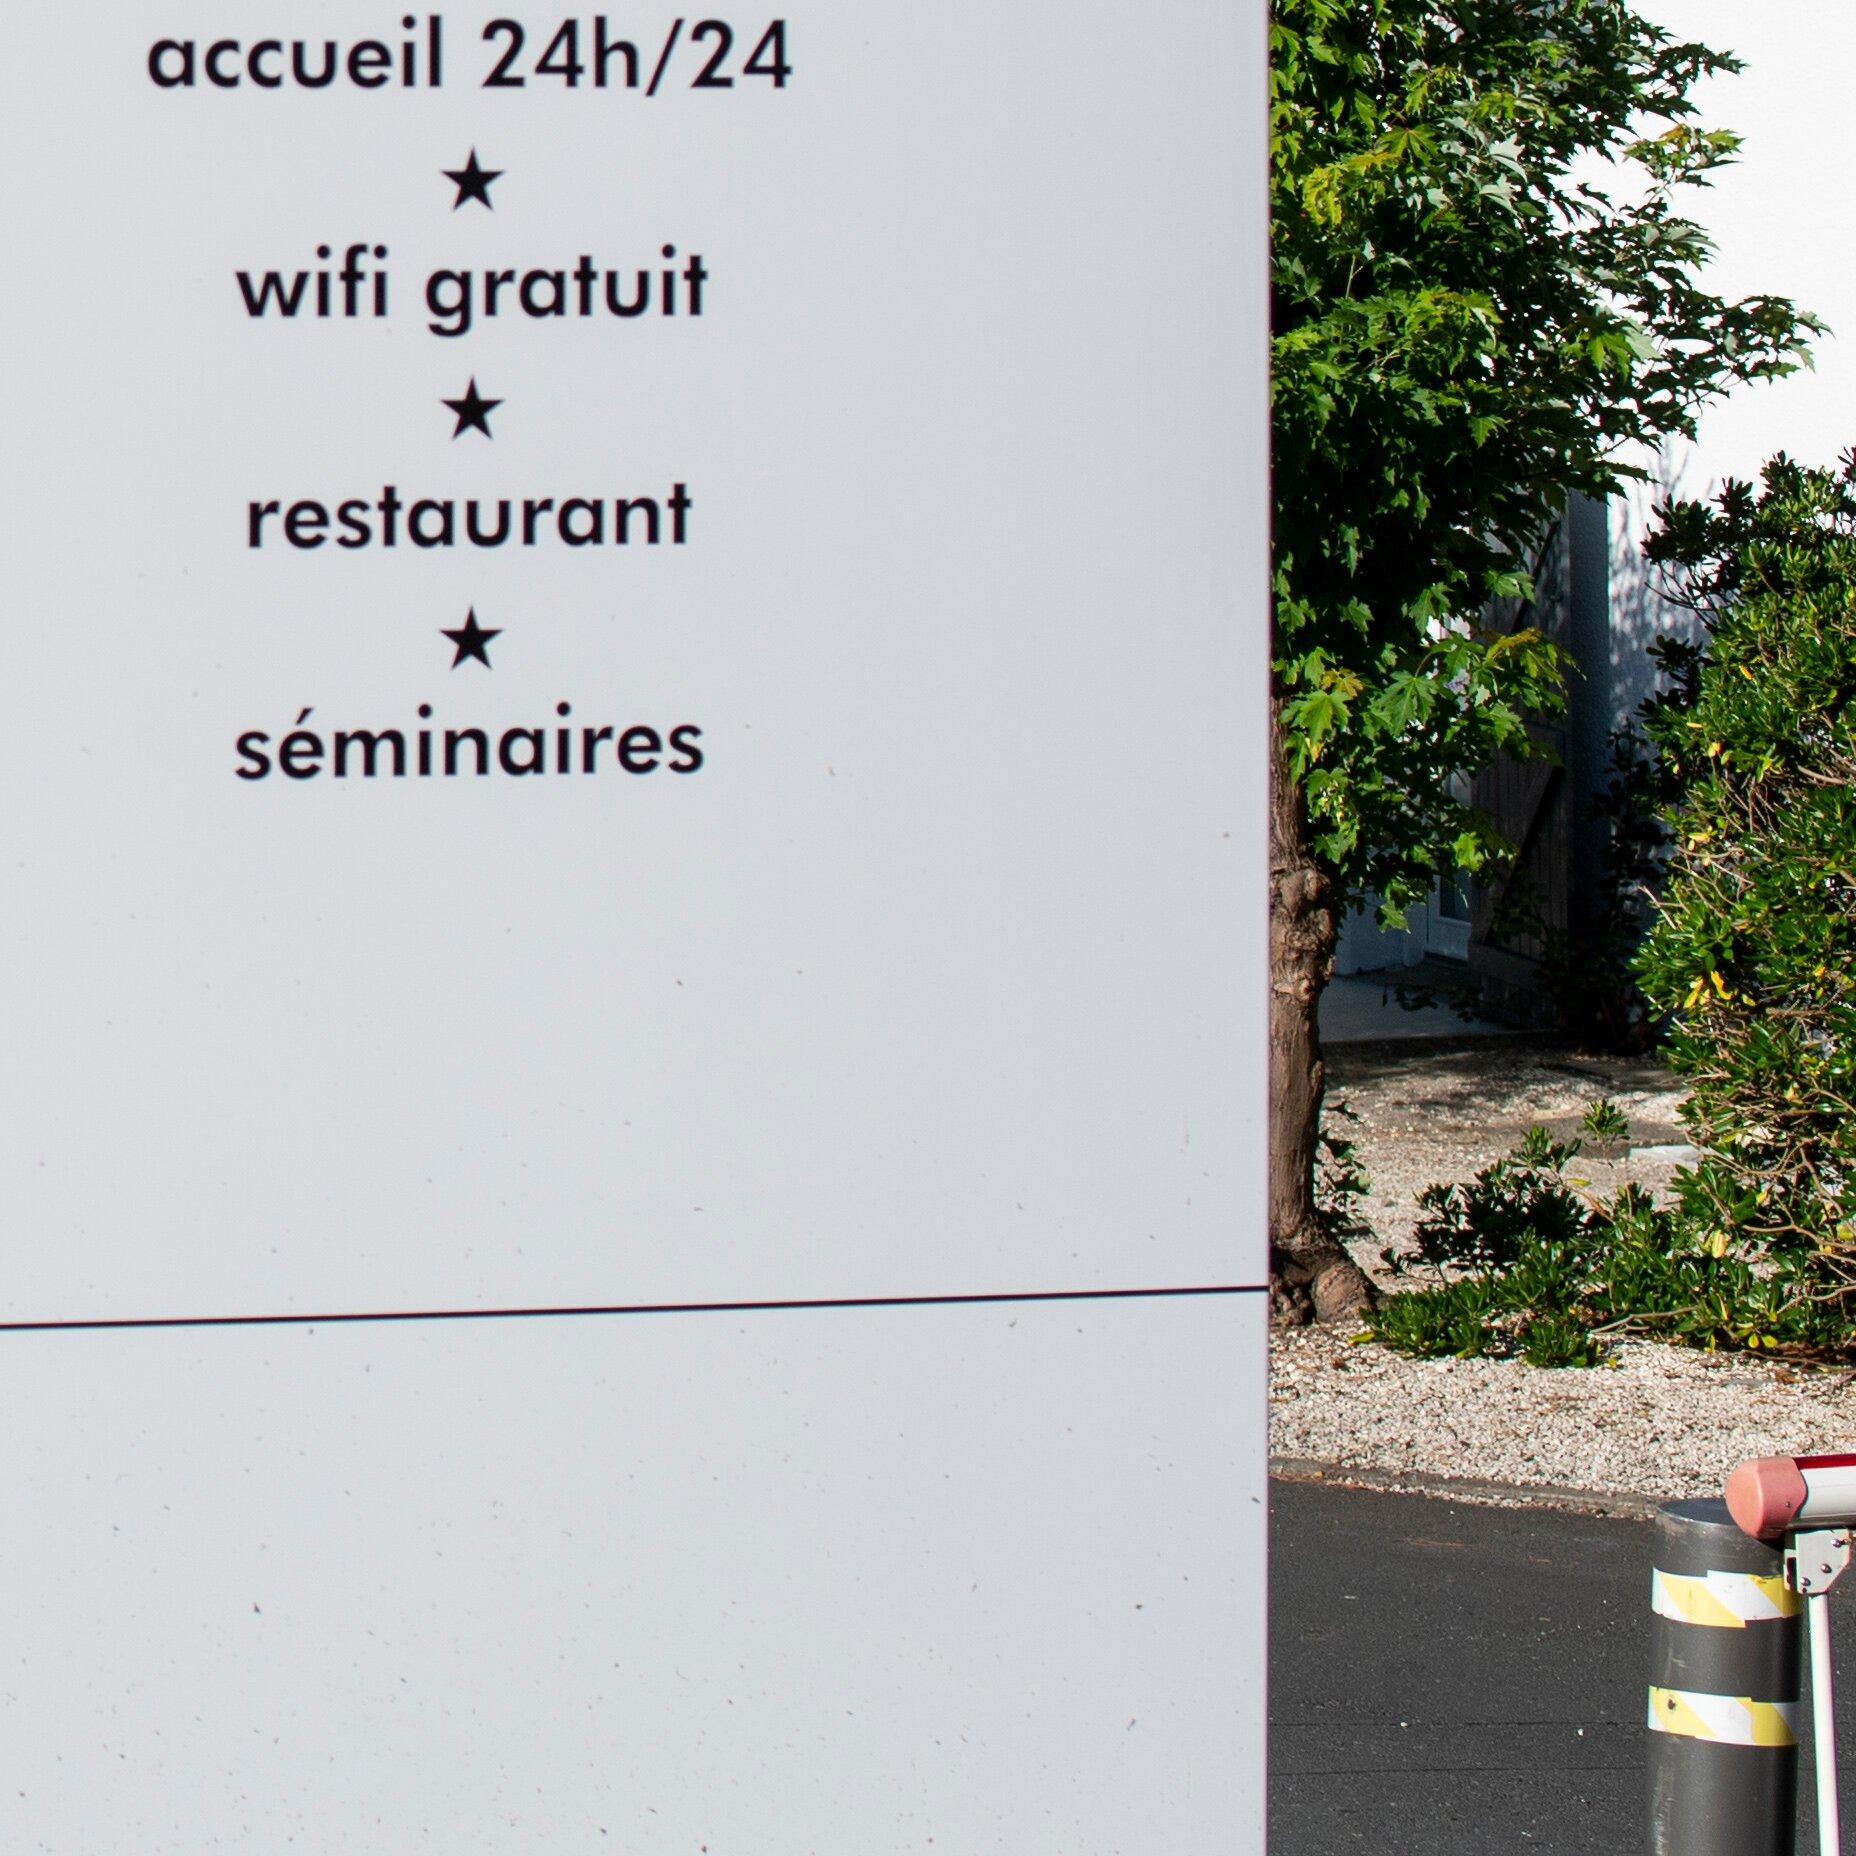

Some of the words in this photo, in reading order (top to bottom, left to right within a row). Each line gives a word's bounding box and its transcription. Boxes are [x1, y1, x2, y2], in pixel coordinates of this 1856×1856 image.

[148, 14, 442, 90] accueil
[482, 15, 792, 97] 24h/24
[235, 243, 388, 317] wifi
[425, 244, 708, 338] gratuit
[249, 483, 692, 550] restaurant
[235, 702, 704, 781] séminaires
